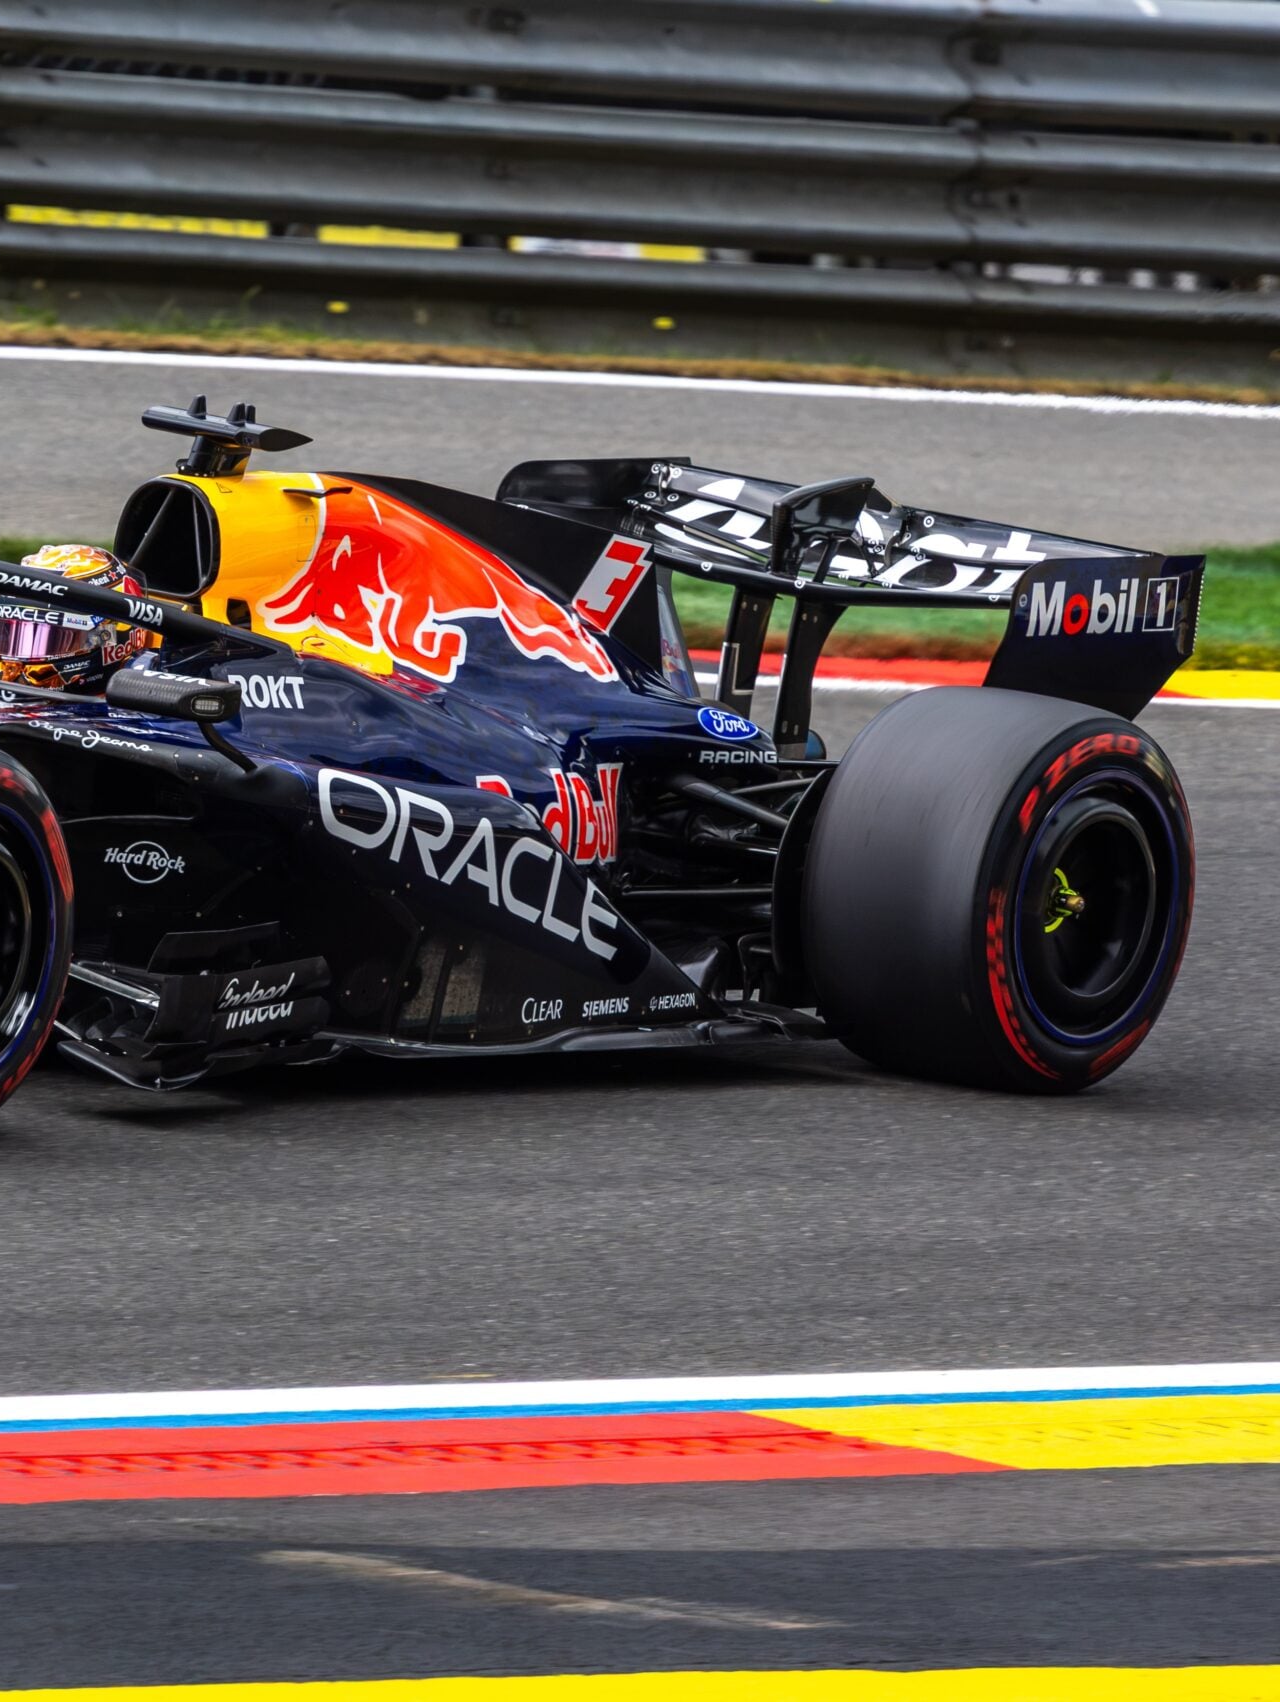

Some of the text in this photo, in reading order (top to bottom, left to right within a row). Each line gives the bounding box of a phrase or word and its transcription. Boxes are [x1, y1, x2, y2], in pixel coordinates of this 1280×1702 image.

[124, 598, 163, 627] VISA
[1025, 578, 1140, 637] Mobil
[227, 674, 305, 709] ROKT
[708, 709, 750, 733] Ford
[28, 720, 153, 752] Pepe Jeans
[699, 750, 778, 764] RACING
[1043, 733, 1142, 794] ZERO
[566, 762, 624, 866] Bull
[104, 847, 186, 873] Hard Rock
[317, 768, 619, 961] ORACLE
[521, 997, 564, 1024] CLEAR
[582, 997, 630, 1018] SIEMENS
[658, 993, 696, 1010] HEXAGON
